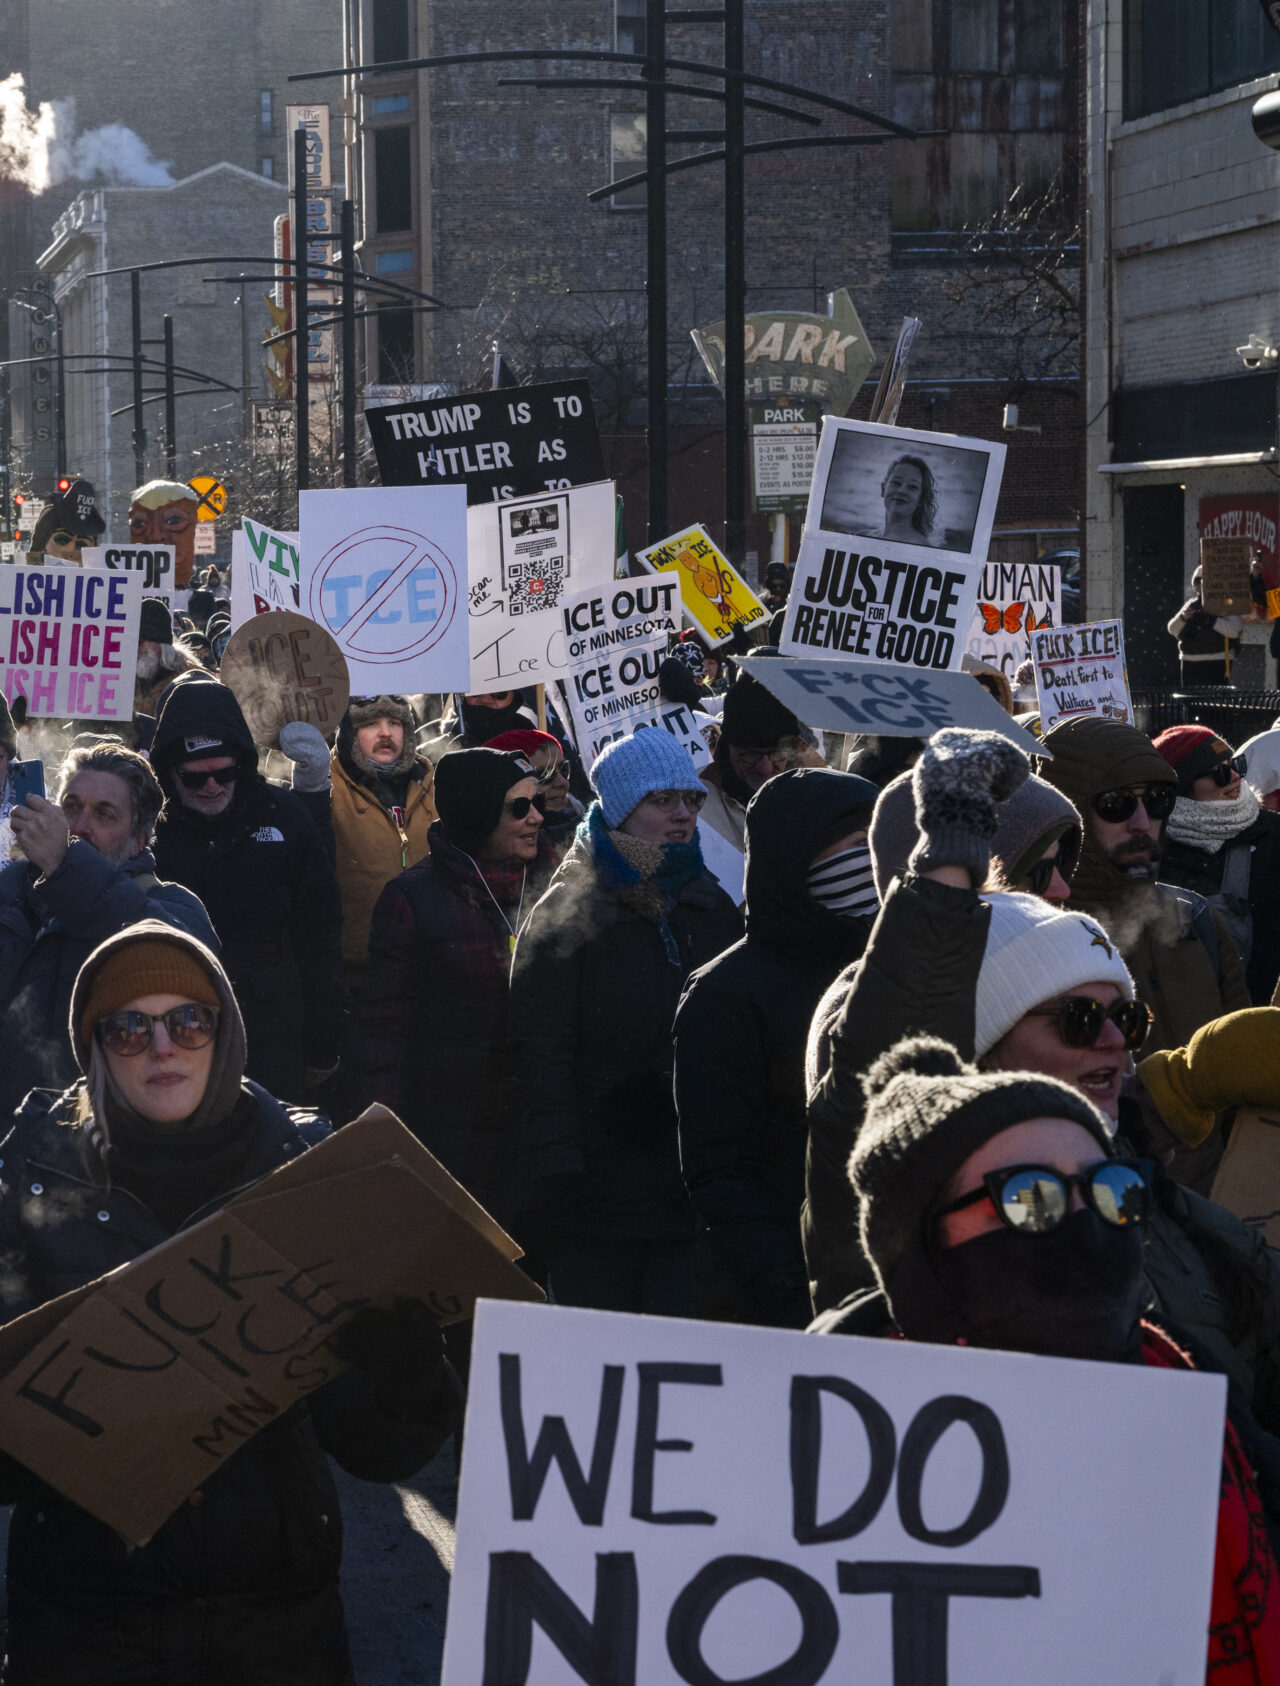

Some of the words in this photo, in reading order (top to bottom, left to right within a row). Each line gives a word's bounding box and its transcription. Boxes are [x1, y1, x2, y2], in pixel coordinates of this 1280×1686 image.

[385, 404, 482, 440] TRUMP
[508, 402, 531, 425] IS
[553, 395, 583, 420] TO
[764, 408, 806, 422] PARK
[417, 441, 513, 479] HITLER
[538, 439, 567, 463] AS
[492, 486, 515, 501] IS
[1204, 510, 1243, 538] HAPPY
[1245, 510, 1276, 554] HOUR
[645, 547, 677, 569] FUCK
[690, 540, 713, 559] ICE
[712, 555, 735, 594] VS
[73, 575, 128, 620] ICE
[323, 567, 438, 629] ICE
[473, 592, 491, 608] me
[564, 598, 605, 636] ICE
[611, 583, 677, 619] OUT
[804, 548, 966, 630] JUSTICE
[714, 626, 731, 639] EL
[869, 607, 884, 621] FOR
[69, 623, 125, 668] ICE
[248, 629, 321, 688] ICE
[473, 628, 540, 681] Ice
[569, 639, 586, 657] OF
[590, 617, 676, 650] MINNESOTA
[792, 604, 873, 656] RENEE
[875, 620, 955, 670] GOOD
[1036, 633, 1075, 661] FUCK
[1076, 625, 1120, 657] ICE!
[67, 671, 121, 715] ICE
[574, 664, 614, 703] ICE
[618, 650, 668, 687] OU
[1041, 667, 1078, 690] Death
[1078, 666, 1099, 683] first
[1102, 665, 1114, 680] to
[251, 688, 333, 731] OUT
[584, 706, 599, 723] OF
[602, 685, 661, 718] MINNESO
[633, 706, 691, 737] UT
[826, 695, 956, 729] ICE
[1053, 691, 1094, 712] Vultures
[1097, 691, 1114, 703] and
[16, 1233, 282, 1438] FUCK
[198, 1257, 368, 1379] ICE
[191, 1384, 281, 1459] MN
[498, 1352, 724, 1527] WE
[789, 1374, 1011, 1548] DO
[480, 1551, 1042, 1686] NOT
